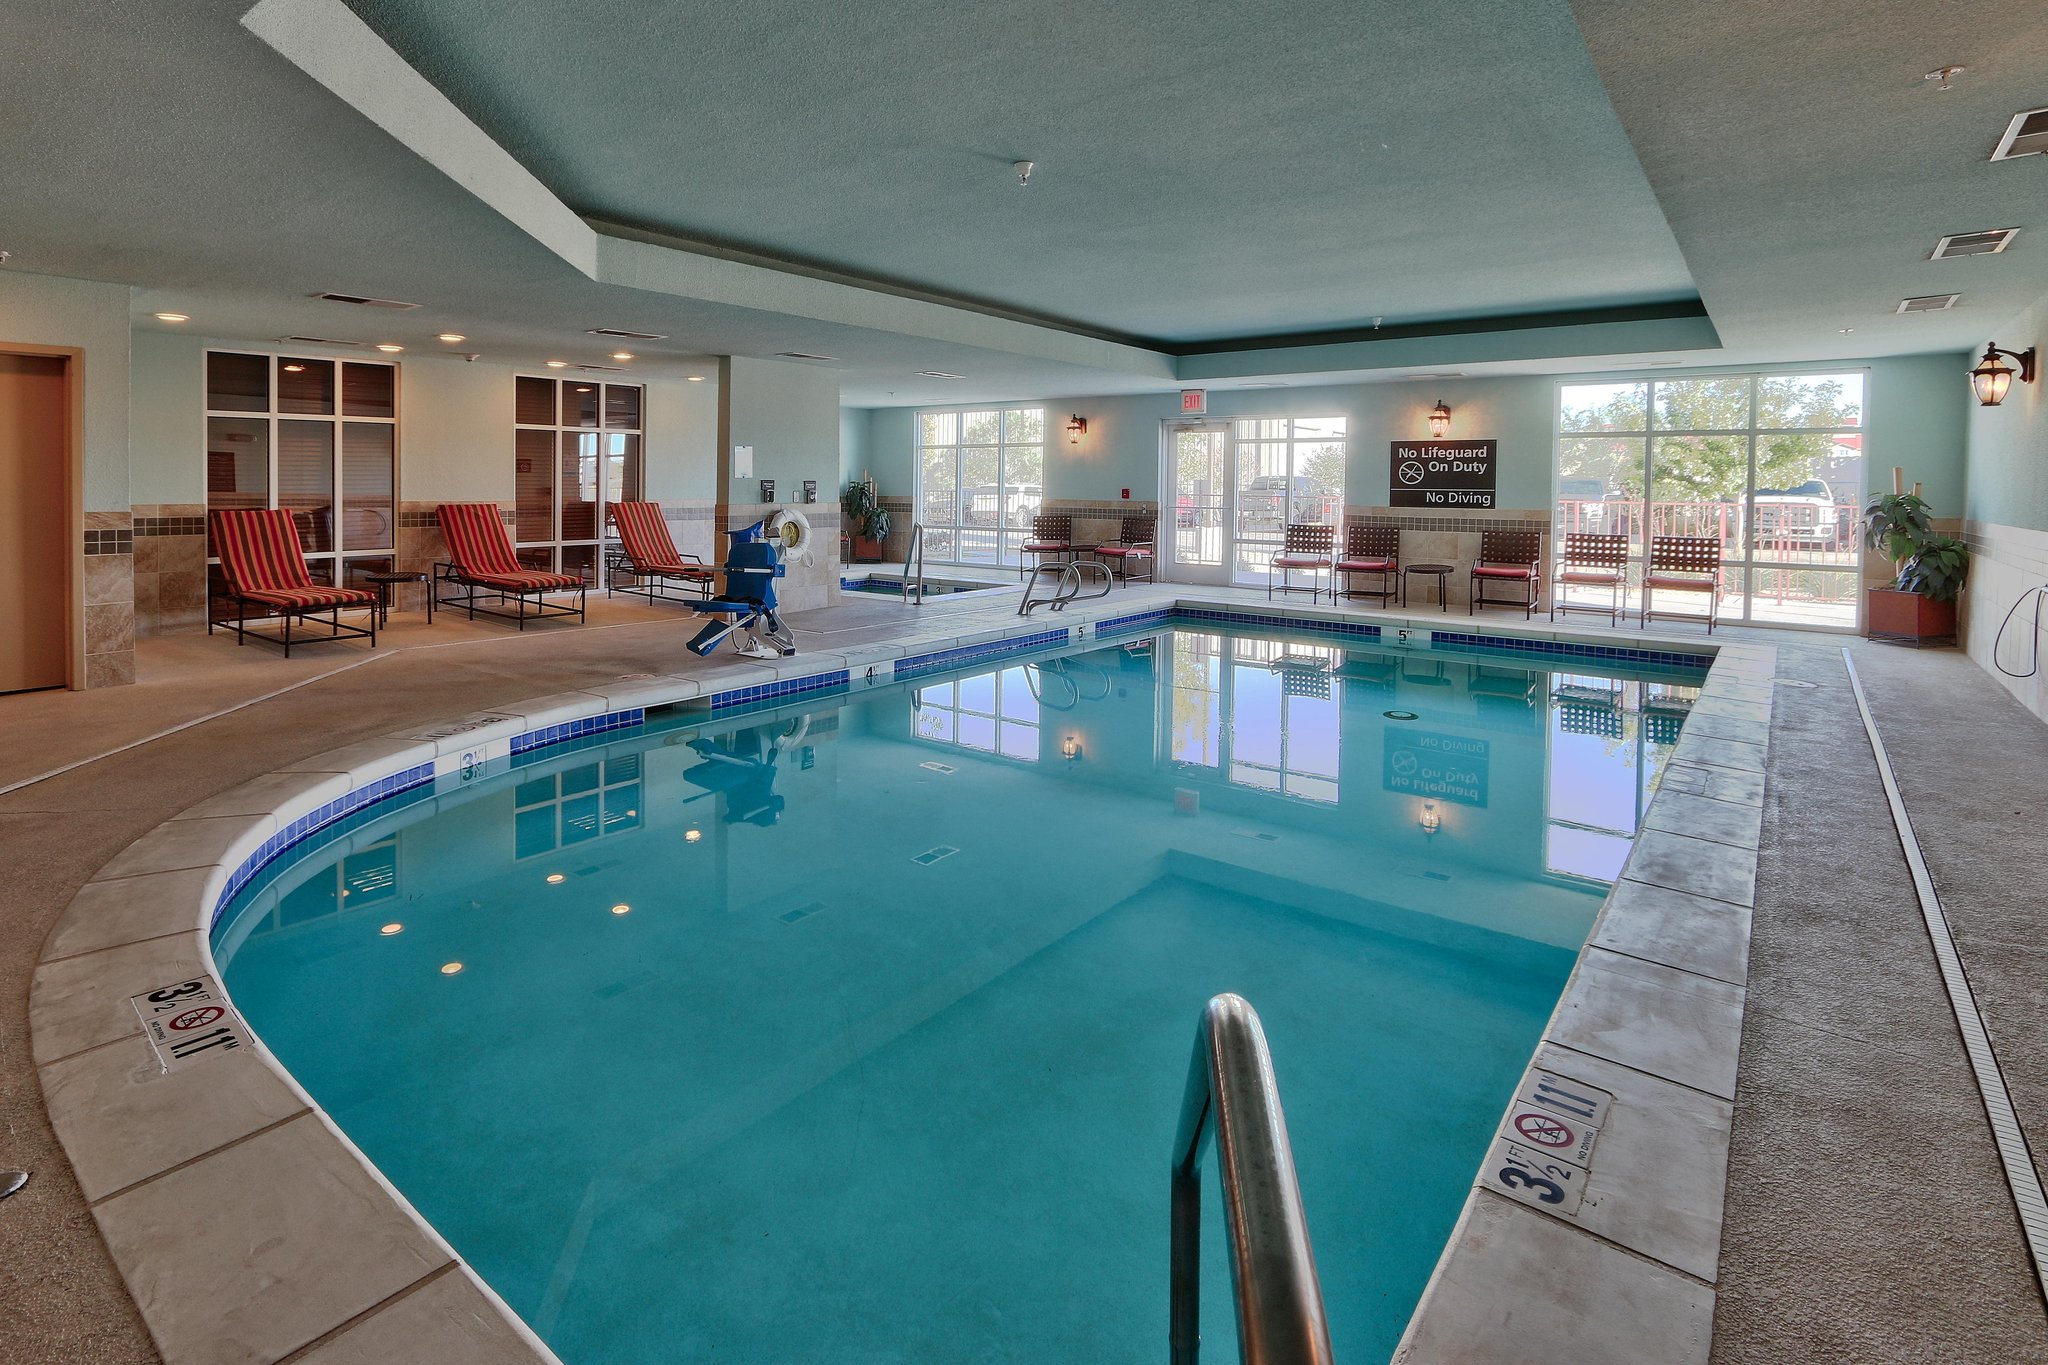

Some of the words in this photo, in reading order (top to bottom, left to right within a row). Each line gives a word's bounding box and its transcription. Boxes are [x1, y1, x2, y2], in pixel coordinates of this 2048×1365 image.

[1184, 395, 1200, 409] EXIT
[1398, 448, 1417, 458] No
[1421, 446, 1487, 460] Lifeguard
[1428, 461, 1448, 472] On
[1453, 461, 1487, 474] Duty
[1426, 492, 1444, 503] No
[1448, 492, 1491, 506] Diving
[866, 666, 873, 677] 4
[170, 1028, 236, 1059] 1.1
[1541, 1074, 1557, 1086] M
[1533, 1083, 1597, 1119] 1.1
[1581, 1131, 1594, 1151] DIVING
[1508, 1145, 1524, 1159] FT
[1577, 1151, 1586, 1162] NO
